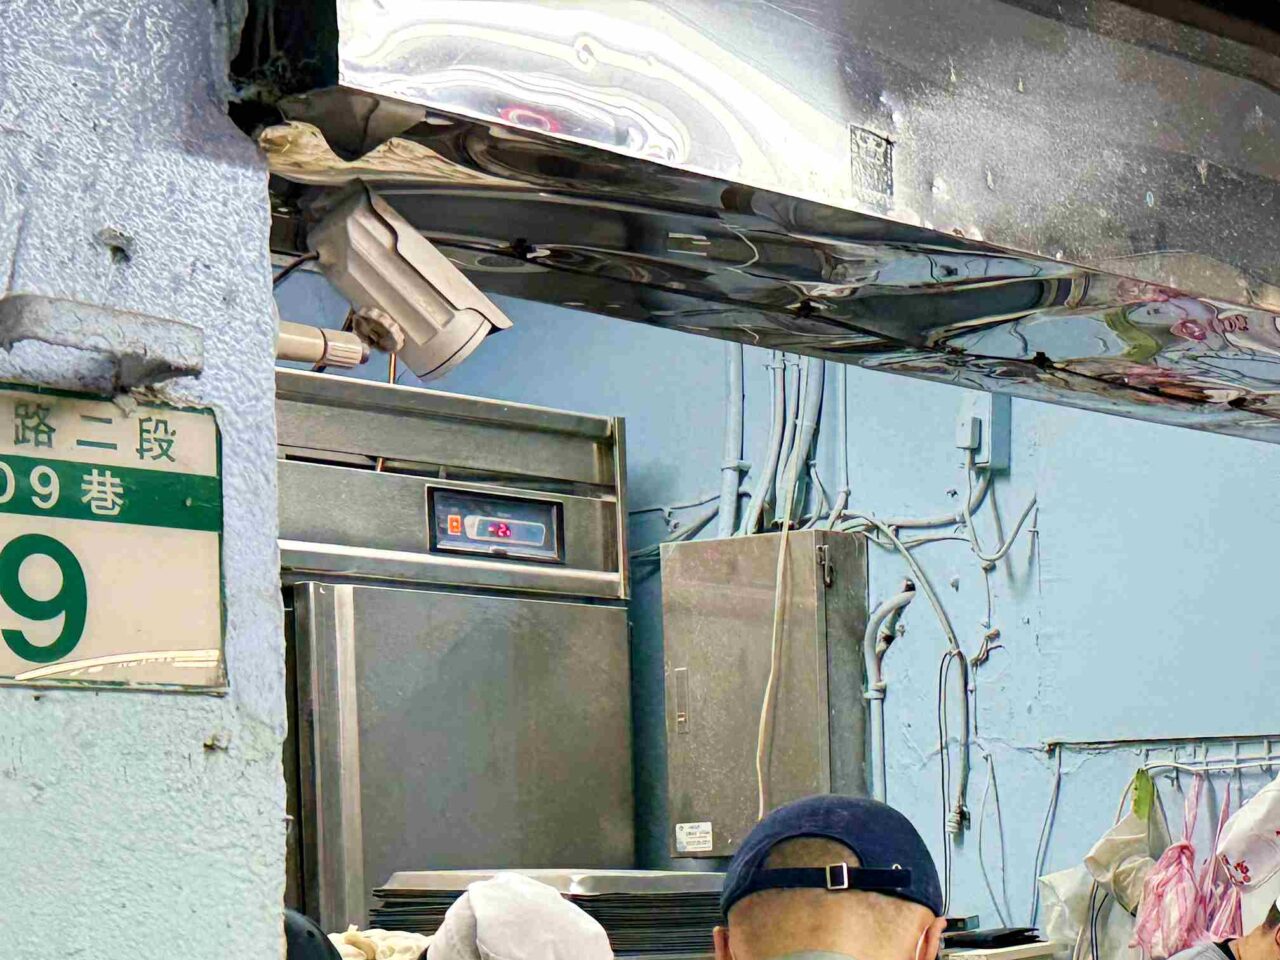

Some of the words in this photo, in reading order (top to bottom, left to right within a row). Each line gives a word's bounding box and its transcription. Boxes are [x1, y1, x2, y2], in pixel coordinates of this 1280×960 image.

[13, 403, 177, 462] 路二段
[0, 533, 88, 664] 9
